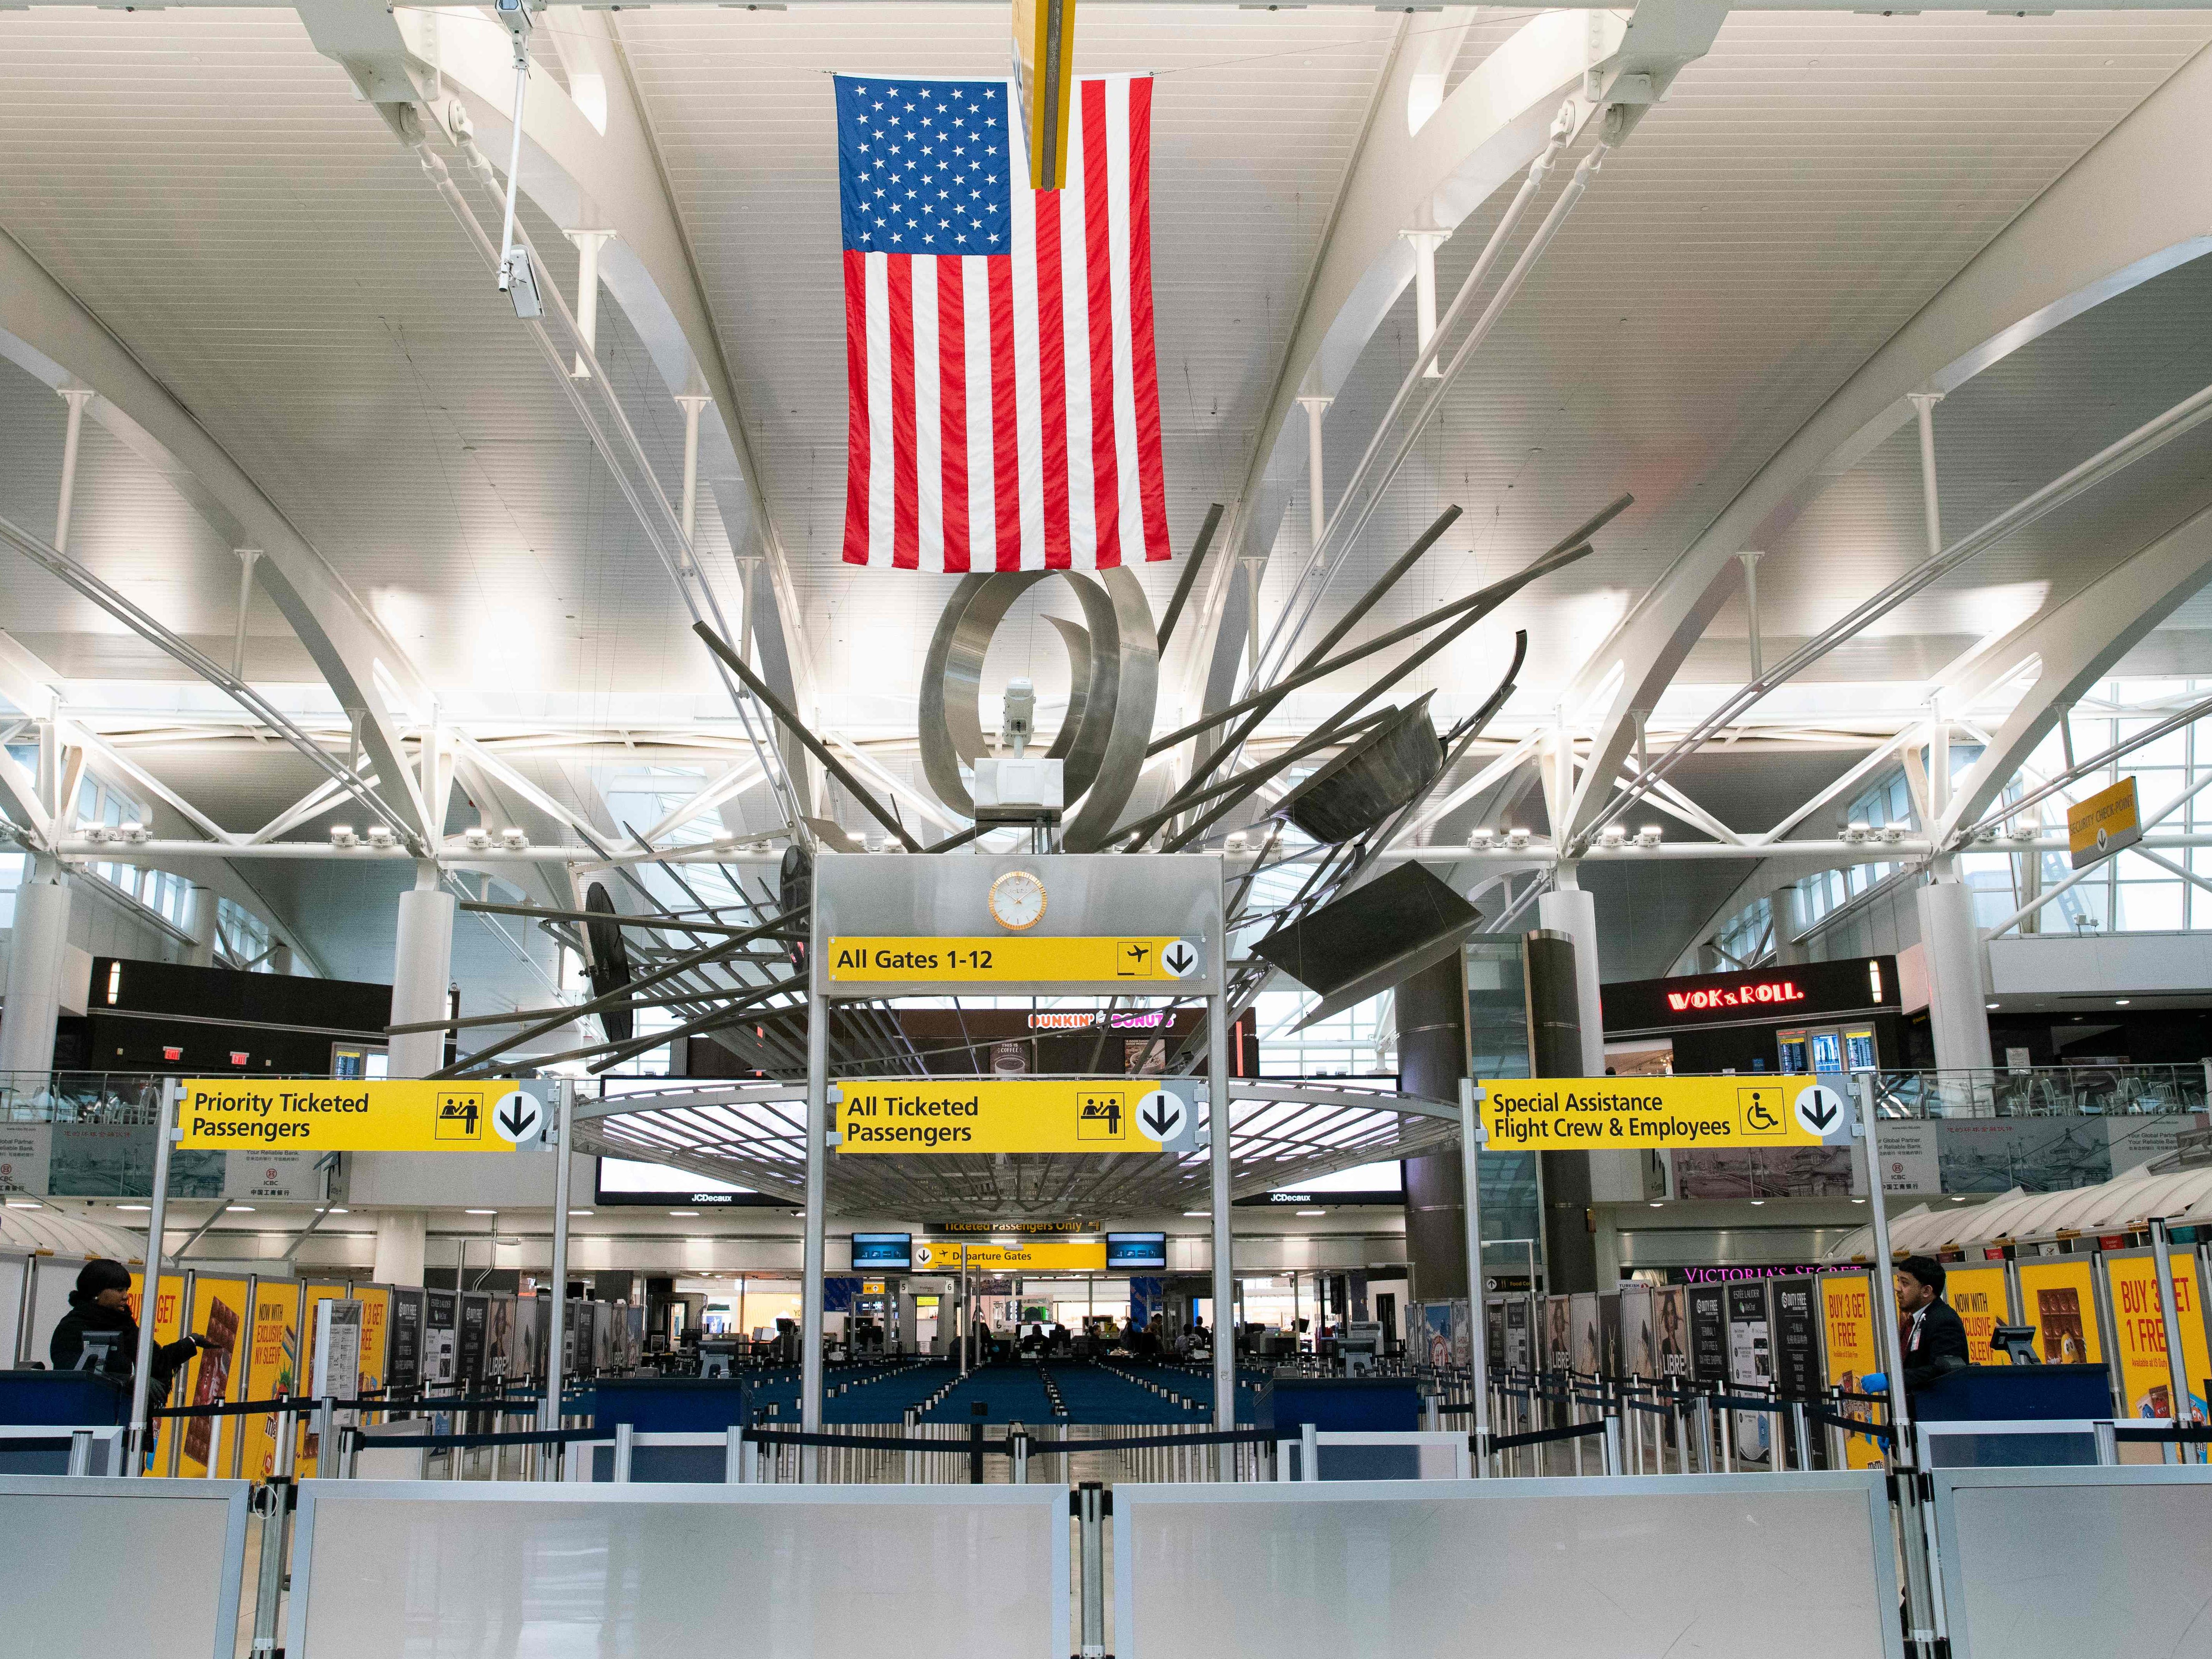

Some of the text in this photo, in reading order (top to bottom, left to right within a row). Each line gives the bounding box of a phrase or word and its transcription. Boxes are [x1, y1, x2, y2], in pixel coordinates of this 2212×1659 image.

[2070, 813, 2094, 836] SECURITY
[837, 949, 992, 968] All Gates 1-12
[1028, 1014, 1094, 1028] DUNKIN'
[166, 1049, 179, 1059] EXIT
[233, 1053, 246, 1065] EXIT
[195, 1092, 369, 1117] Priority Ticketed
[847, 1096, 978, 1116] All Ticketed
[1494, 1092, 1662, 1117] Special Assistance
[193, 1118, 310, 1142] Passengers
[848, 1123, 972, 1147] Passengers
[1495, 1115, 1730, 1142] Flight Crew & Employees
[692, 1194, 732, 1203] JCDecaux
[1271, 1193, 1311, 1202] JCDecaux
[992, 1223, 1053, 1233] Passengers
[1056, 1221, 1082, 1233] Only
[953, 1252, 1032, 1262] Dparture Gates
[1744, 1289, 1759, 1298] LAUDER
[1788, 1293, 1797, 1306] DUTY
[1797, 1293, 1807, 1306] FREE
[1954, 1292, 1988, 1313] NOW WITH
[2121, 1277, 2190, 1313] BUY 3 ET
[128, 1294, 176, 1324] BU GET
[258, 1303, 283, 1321] NOW WITH
[367, 1303, 371, 1325] 3
[372, 1304, 383, 1325] GET
[1710, 1299, 1718, 1311] FREE
[1829, 1293, 1866, 1318] BUY 3 GET
[257, 1325, 283, 1343] EXCLUSIVE
[996, 1320, 1002, 1329] 6
[1831, 1322, 1836, 1346] 1
[361, 1328, 374, 1351] REE
[2126, 1318, 2167, 1352] 1 FRE
[255, 1346, 262, 1364] NY
[1435, 1349, 1443, 1366] #1
[1552, 1351, 1569, 1368] LIBRE
[1663, 1354, 1685, 1375] LIBRE
[2132, 1358, 2148, 1367] Available
[2159, 1359, 2167, 1369] Duty
[488, 1356, 506, 1376] LIBRE
